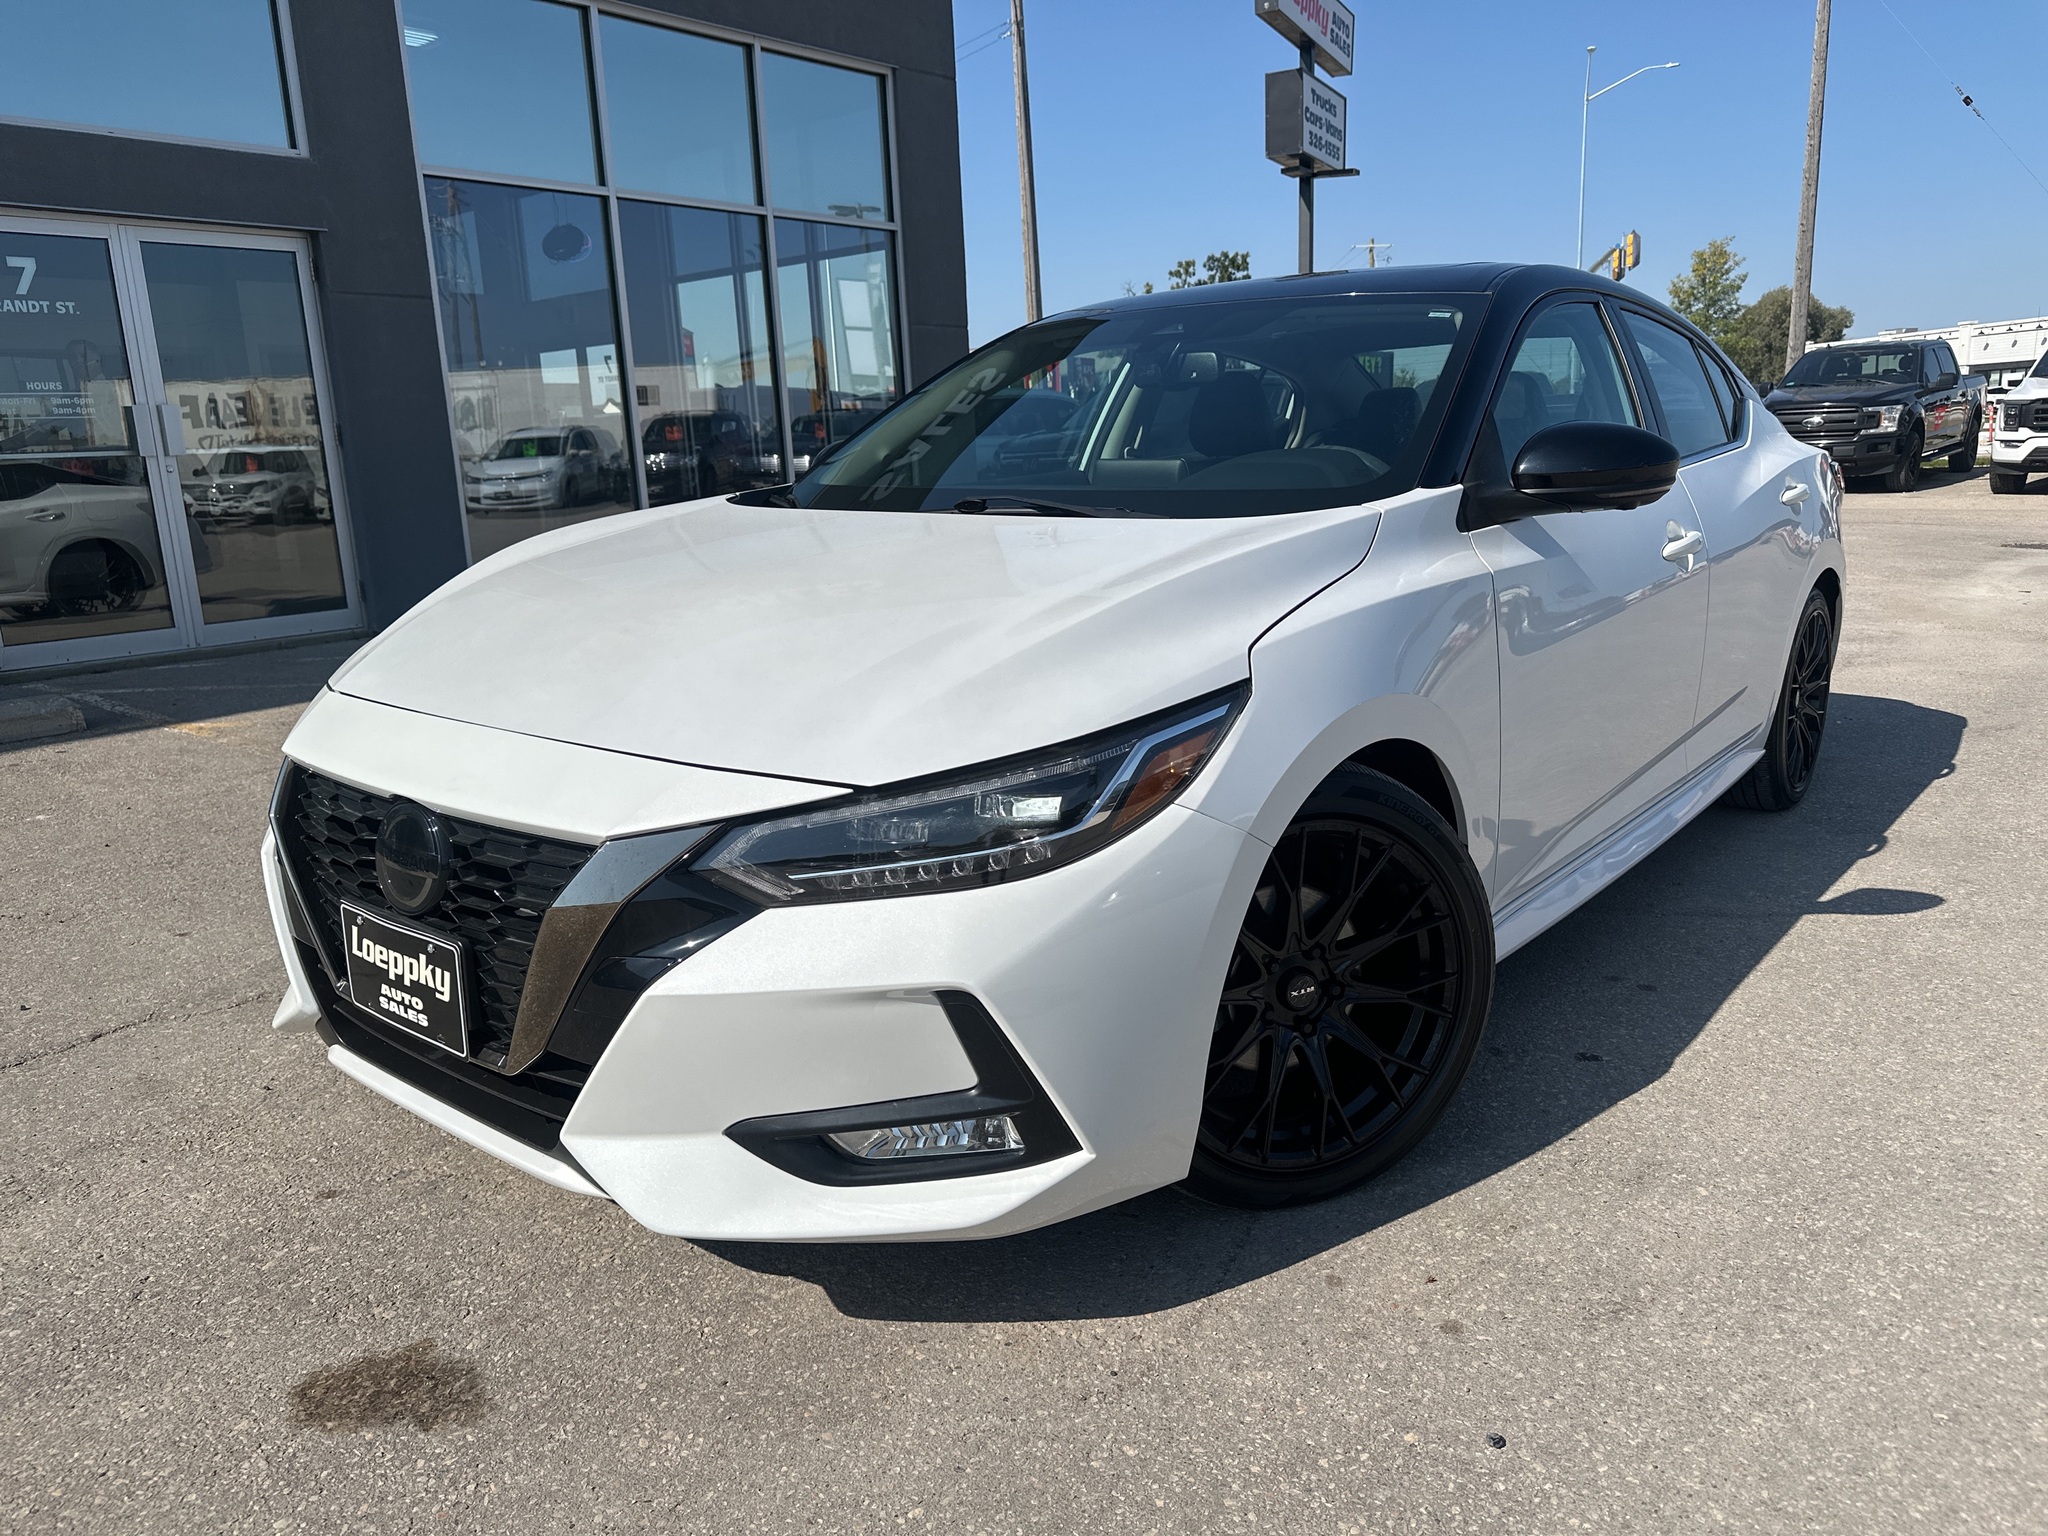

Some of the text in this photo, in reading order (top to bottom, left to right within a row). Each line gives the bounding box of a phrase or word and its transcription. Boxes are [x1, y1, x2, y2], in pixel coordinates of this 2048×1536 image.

[1331, 11, 1350, 39] AUTO
[1330, 28, 1351, 58] SALES
[1311, 87, 1337, 118] Trucks
[6, 255, 37, 295] 7
[0, 299, 80, 314] ANDT ST.
[26, 381, 63, 391] HOURS
[50, 396, 94, 406] 9am-6pm
[52, 406, 96, 415] 9am-4pm
[352, 925, 451, 1003] Loeppky
[381, 983, 424, 1011] AUTO
[1290, 985, 1316, 998] RTX
[379, 996, 429, 1028] SALES
